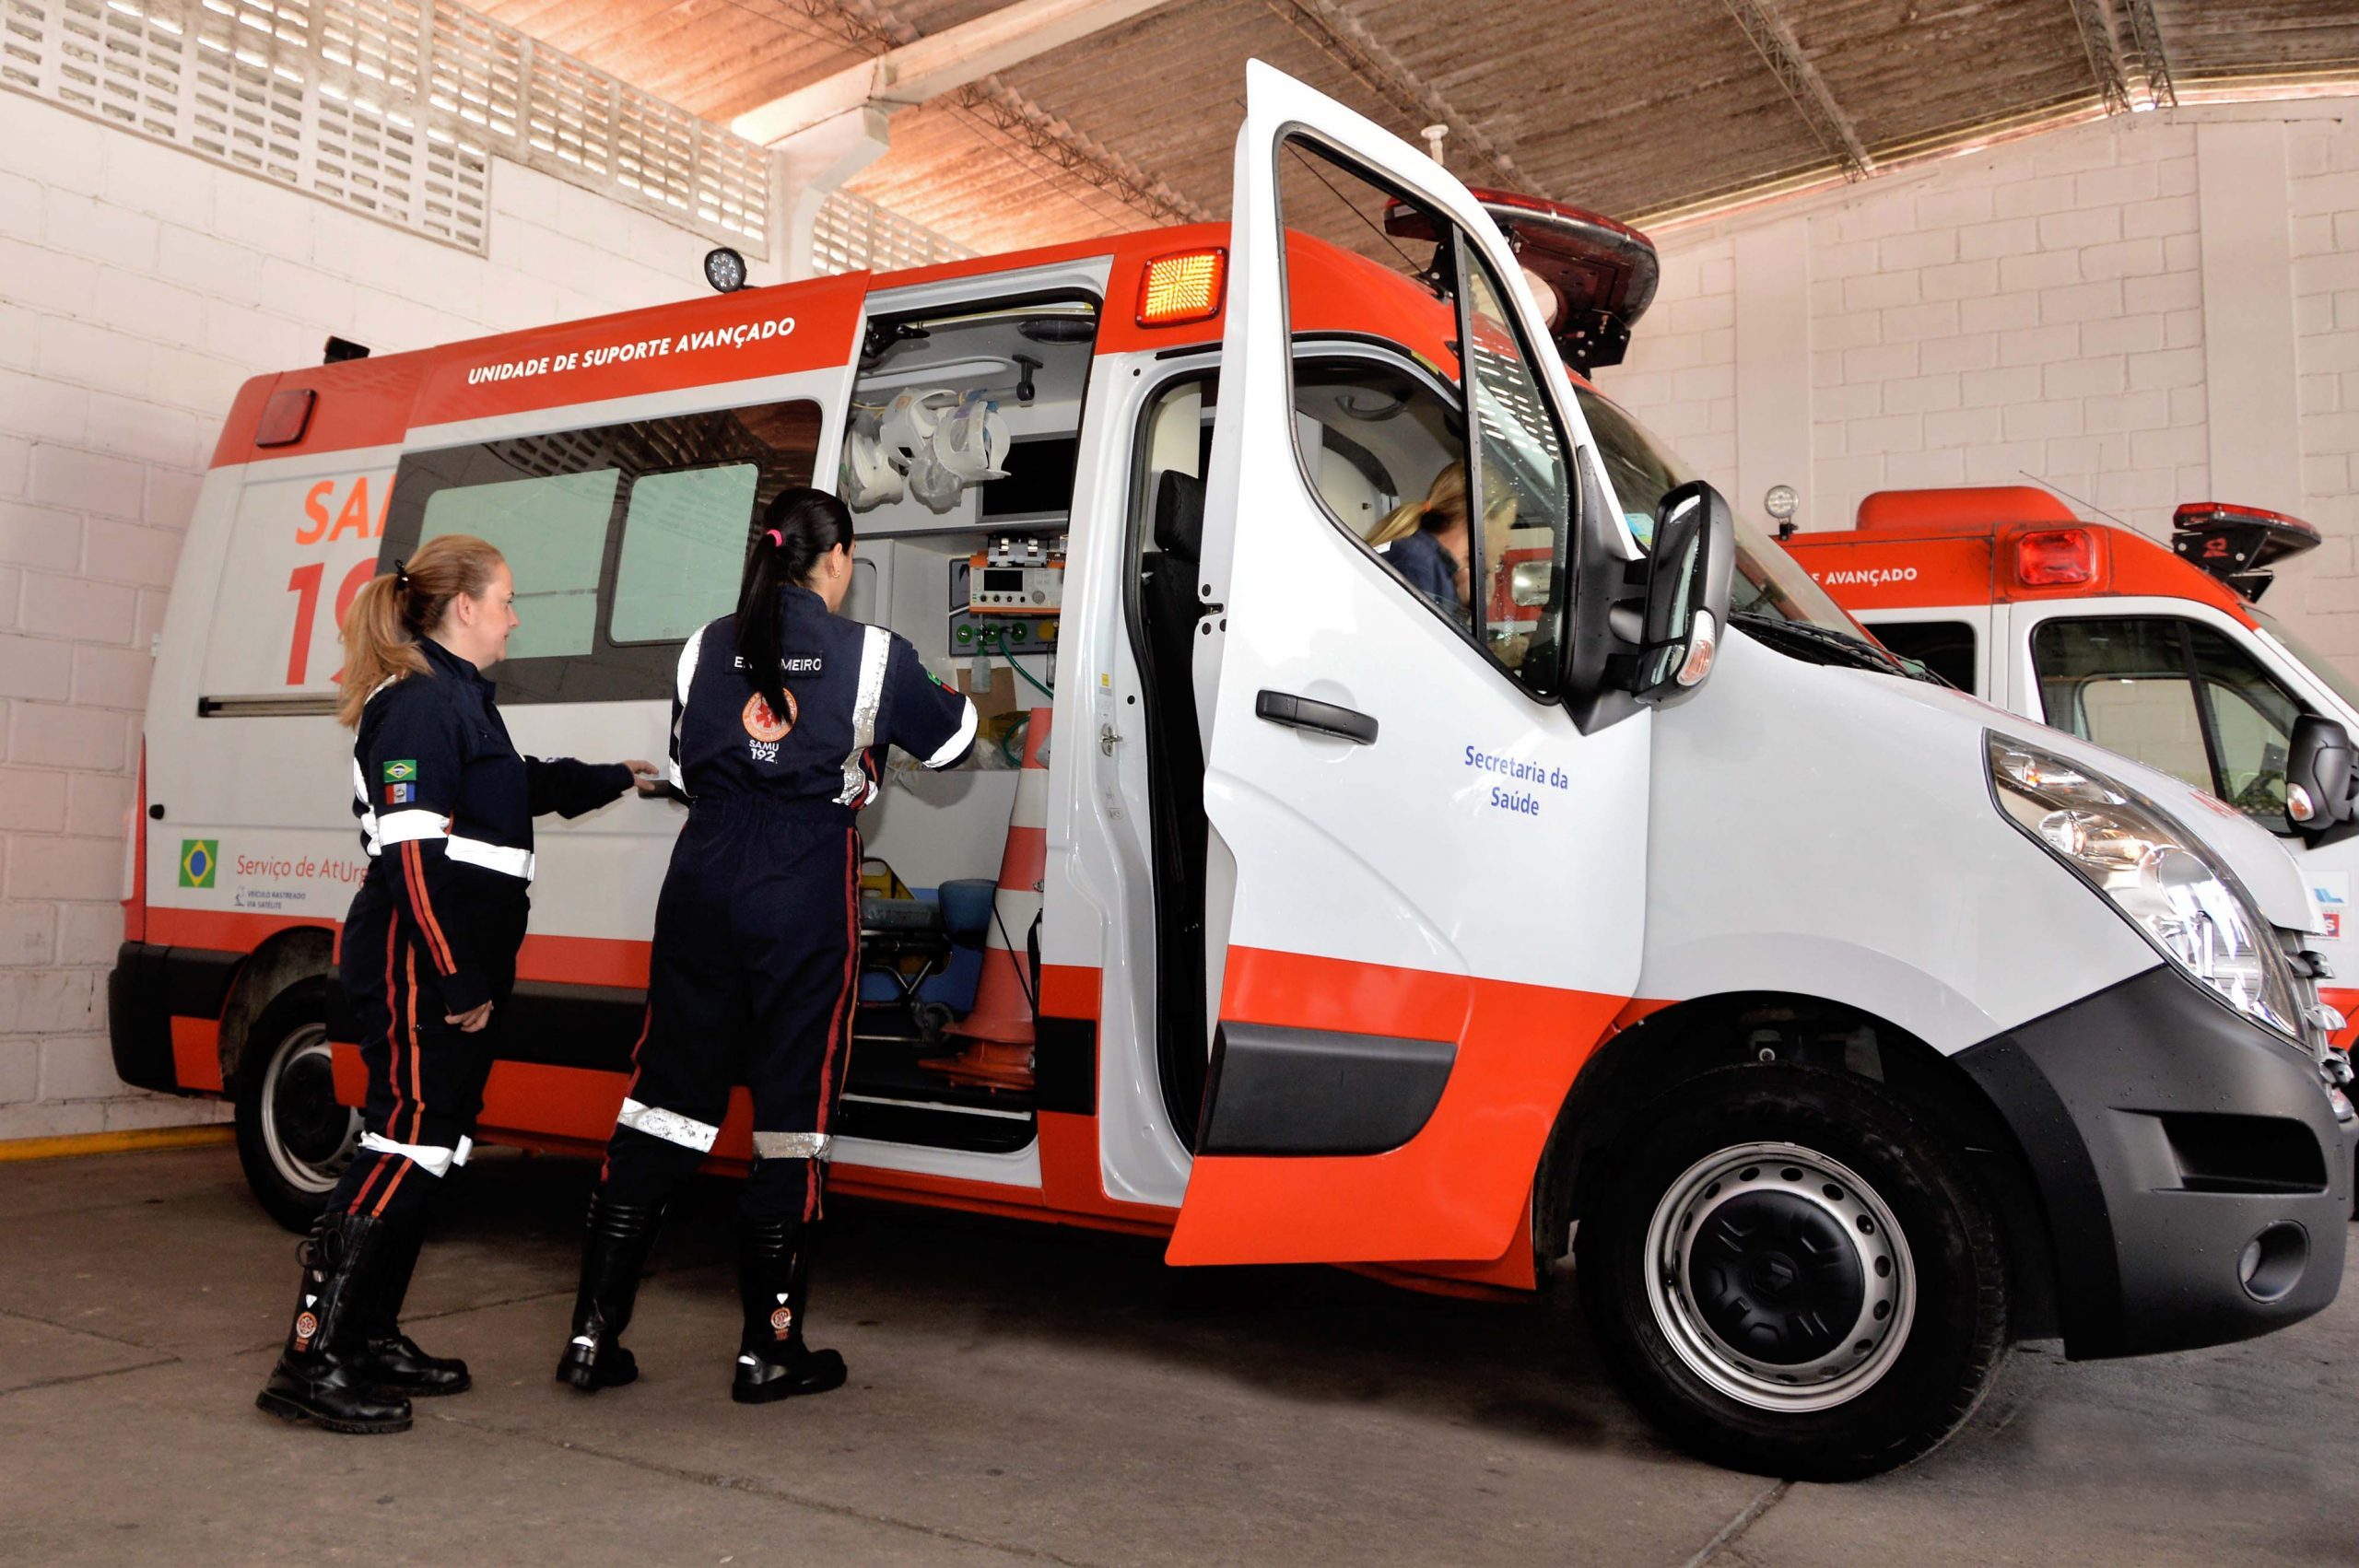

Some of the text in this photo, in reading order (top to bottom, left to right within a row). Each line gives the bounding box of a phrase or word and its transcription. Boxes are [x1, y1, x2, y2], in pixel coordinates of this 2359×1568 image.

[467, 317, 796, 385] UNIDADE DE SUPORTE AVANÇADO
[295, 474, 397, 545] SA
[1825, 568, 1918, 587] AVANÇADO
[749, 739, 780, 752] SAMU
[750, 748, 776, 763] 192
[1465, 744, 1568, 790] Secretaria da
[1491, 786, 1540, 815] Saúde
[236, 855, 291, 881] Serviço
[295, 855, 315, 878] de
